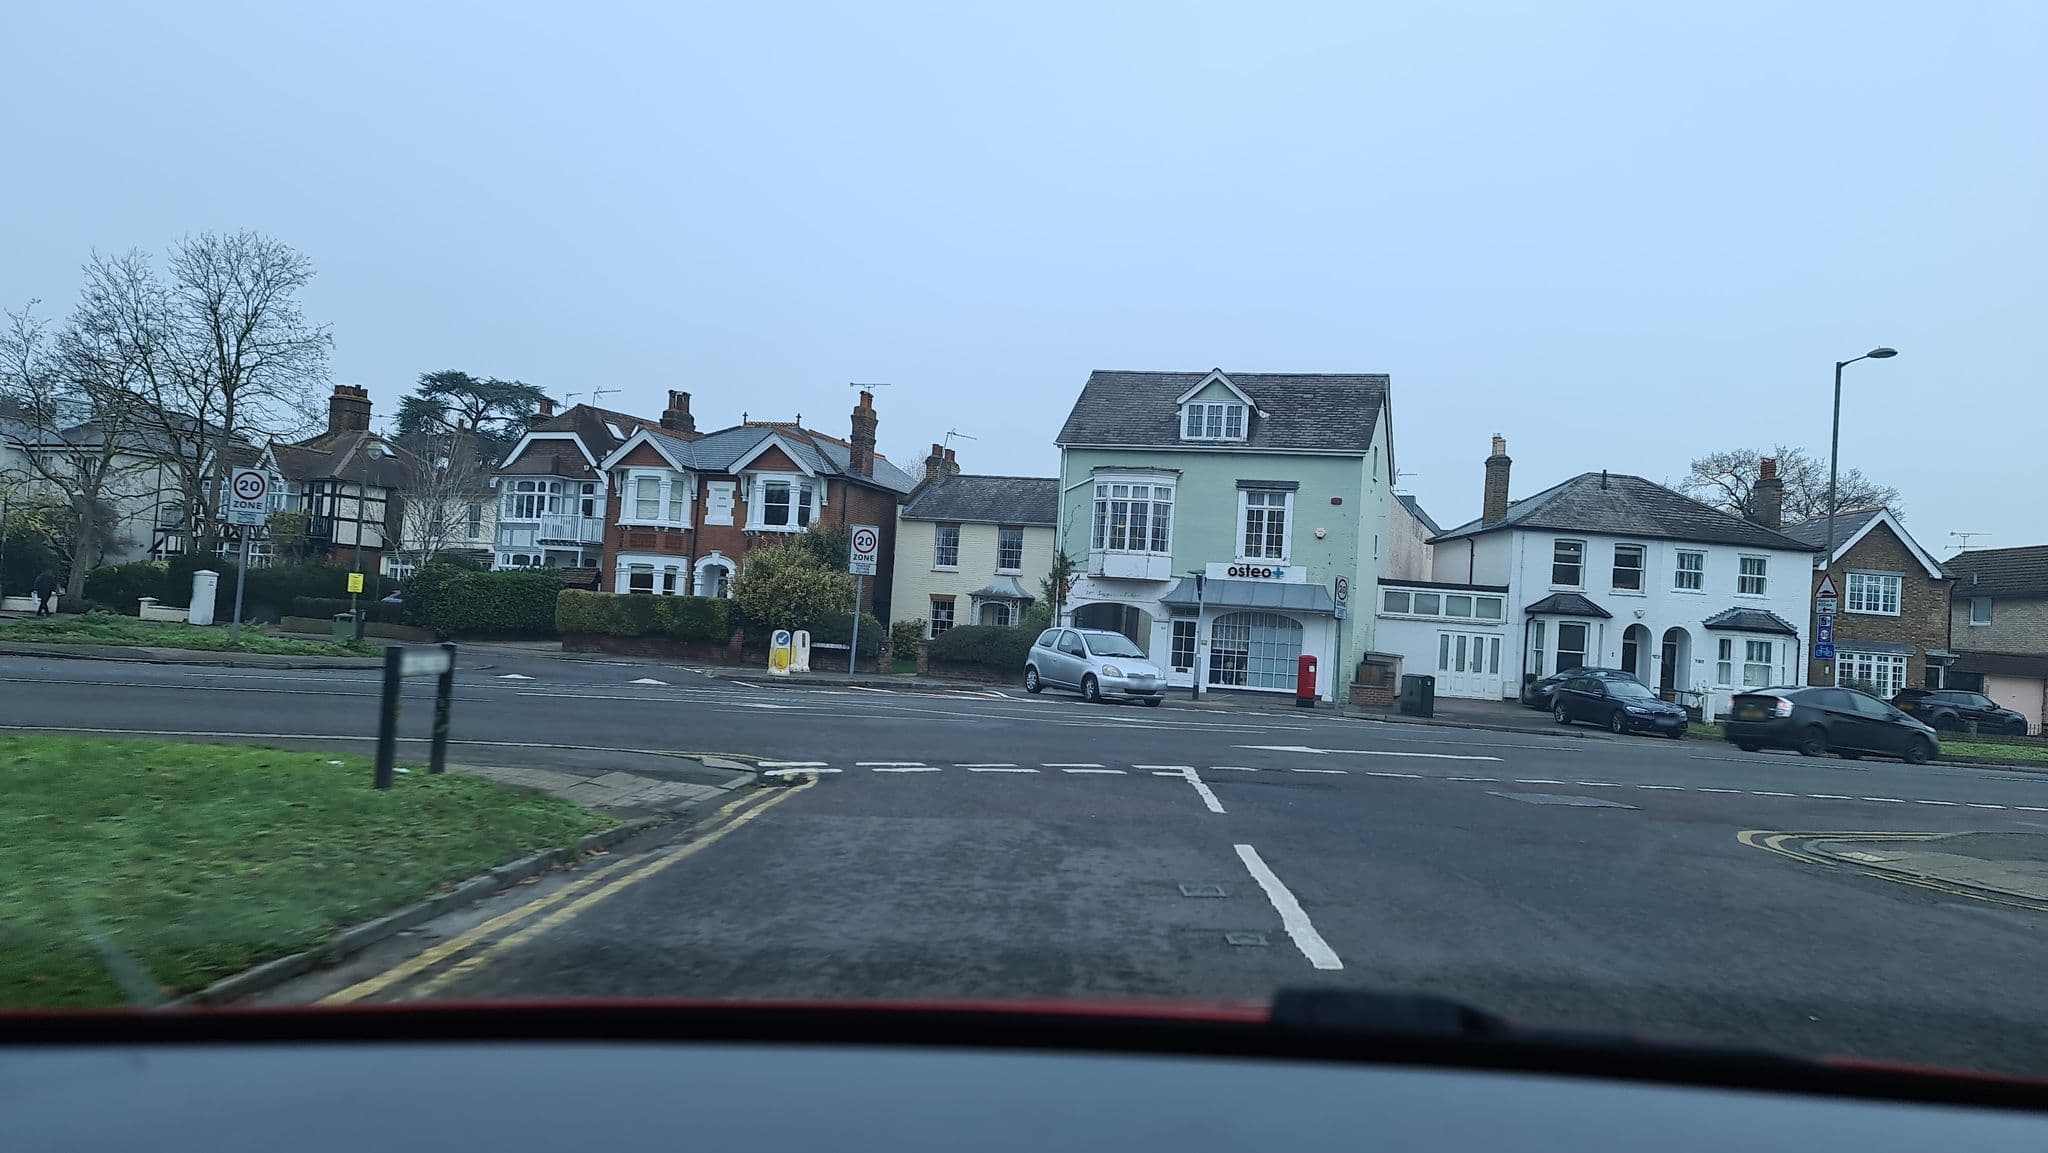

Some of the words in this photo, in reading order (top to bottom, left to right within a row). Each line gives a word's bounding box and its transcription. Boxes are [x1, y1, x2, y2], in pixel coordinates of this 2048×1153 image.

[239, 480, 260, 492] 20
[233, 500, 263, 509] ZONE
[857, 536, 873, 546] 20
[853, 554, 875, 562] ZONE
